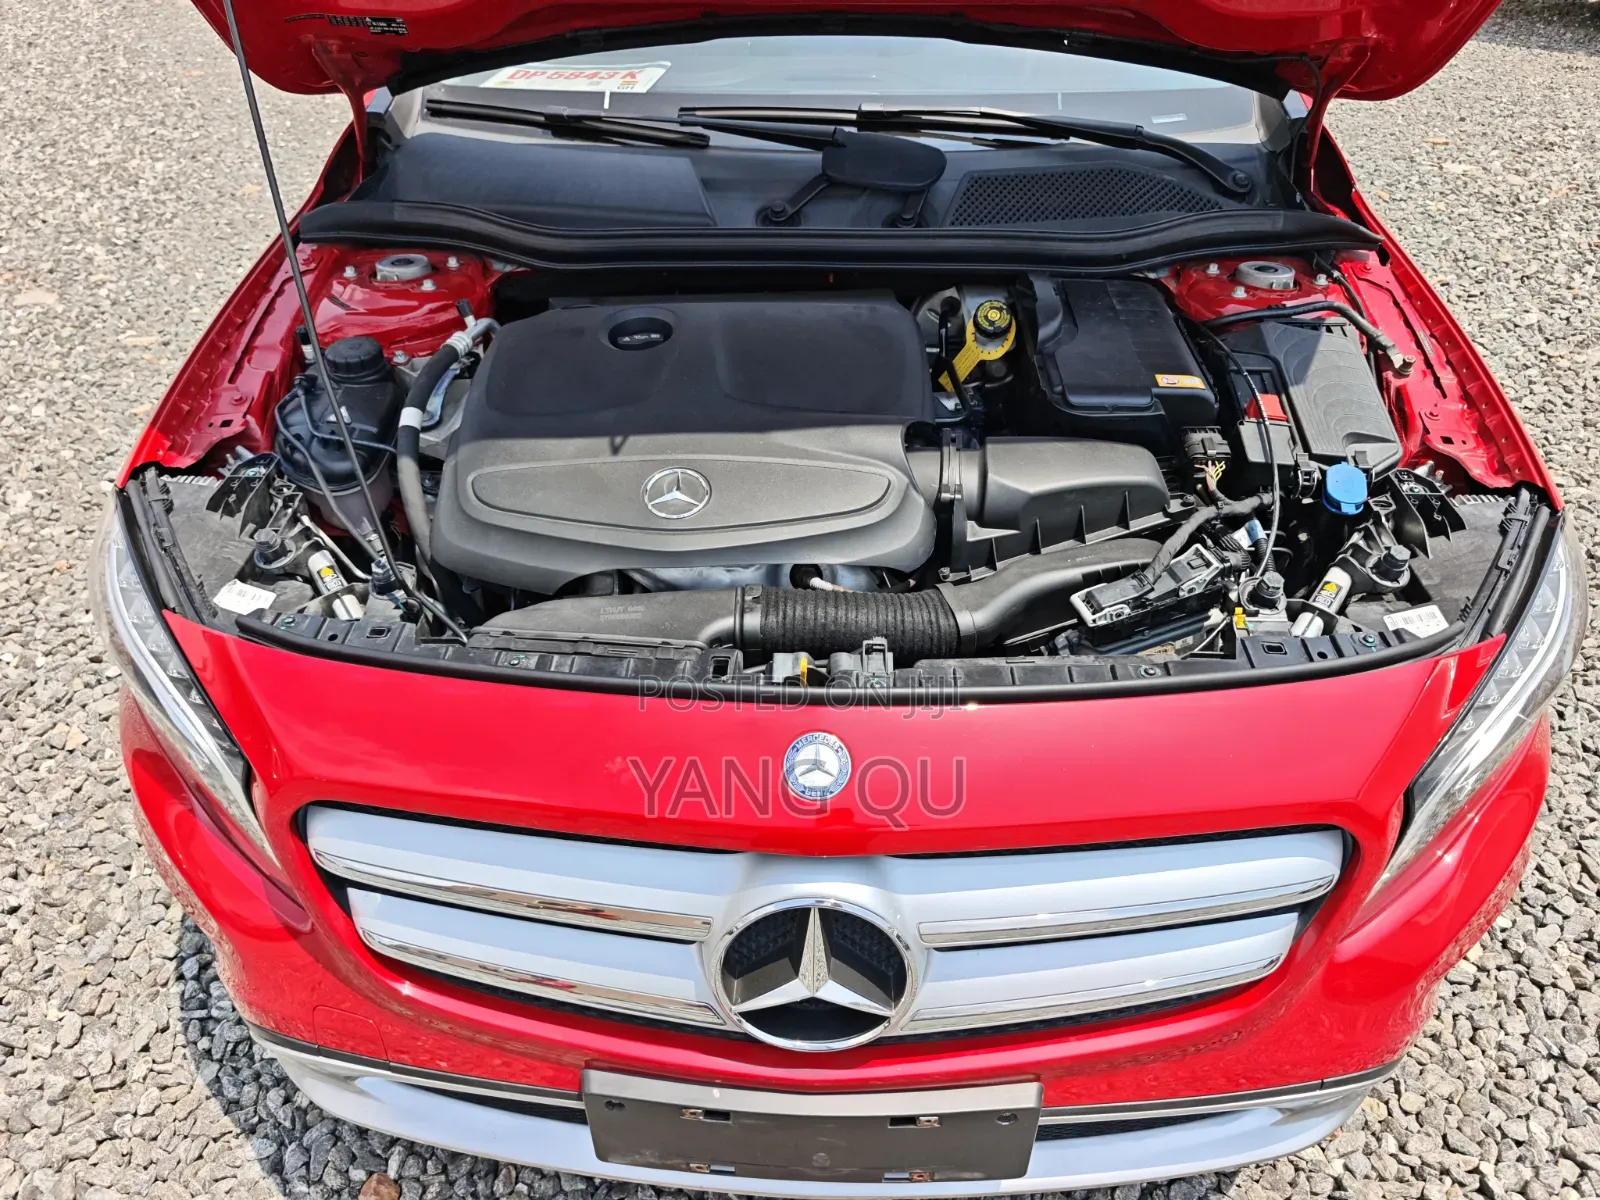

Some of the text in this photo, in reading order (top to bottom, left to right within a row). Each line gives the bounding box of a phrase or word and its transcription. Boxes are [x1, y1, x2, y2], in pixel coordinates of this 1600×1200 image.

[507, 69, 644, 80] DP 5843 K
[795, 734, 840, 750] MERCEDES
